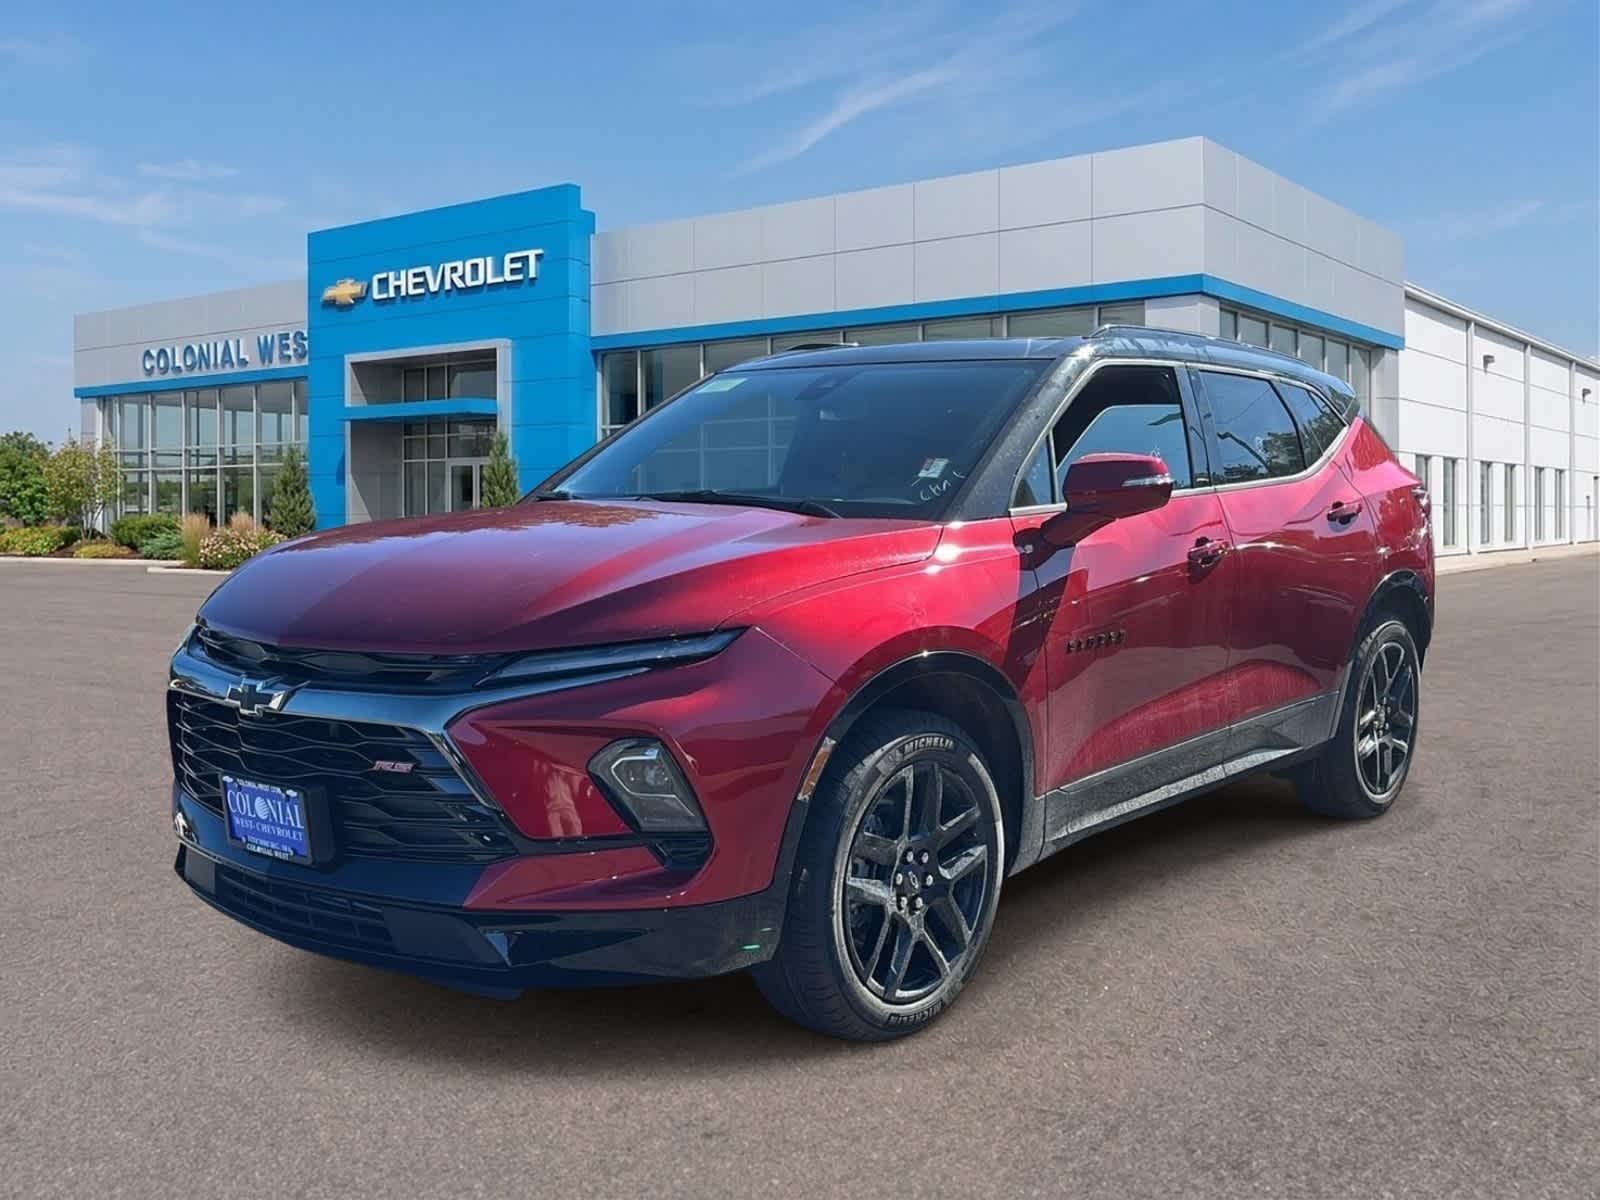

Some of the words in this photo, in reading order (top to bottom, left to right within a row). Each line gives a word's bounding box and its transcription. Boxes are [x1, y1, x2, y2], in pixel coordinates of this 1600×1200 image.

[372, 248, 544, 300] CHEVROLET
[142, 338, 249, 376] COLONIAL
[227, 790, 304, 829] COLONIAL
